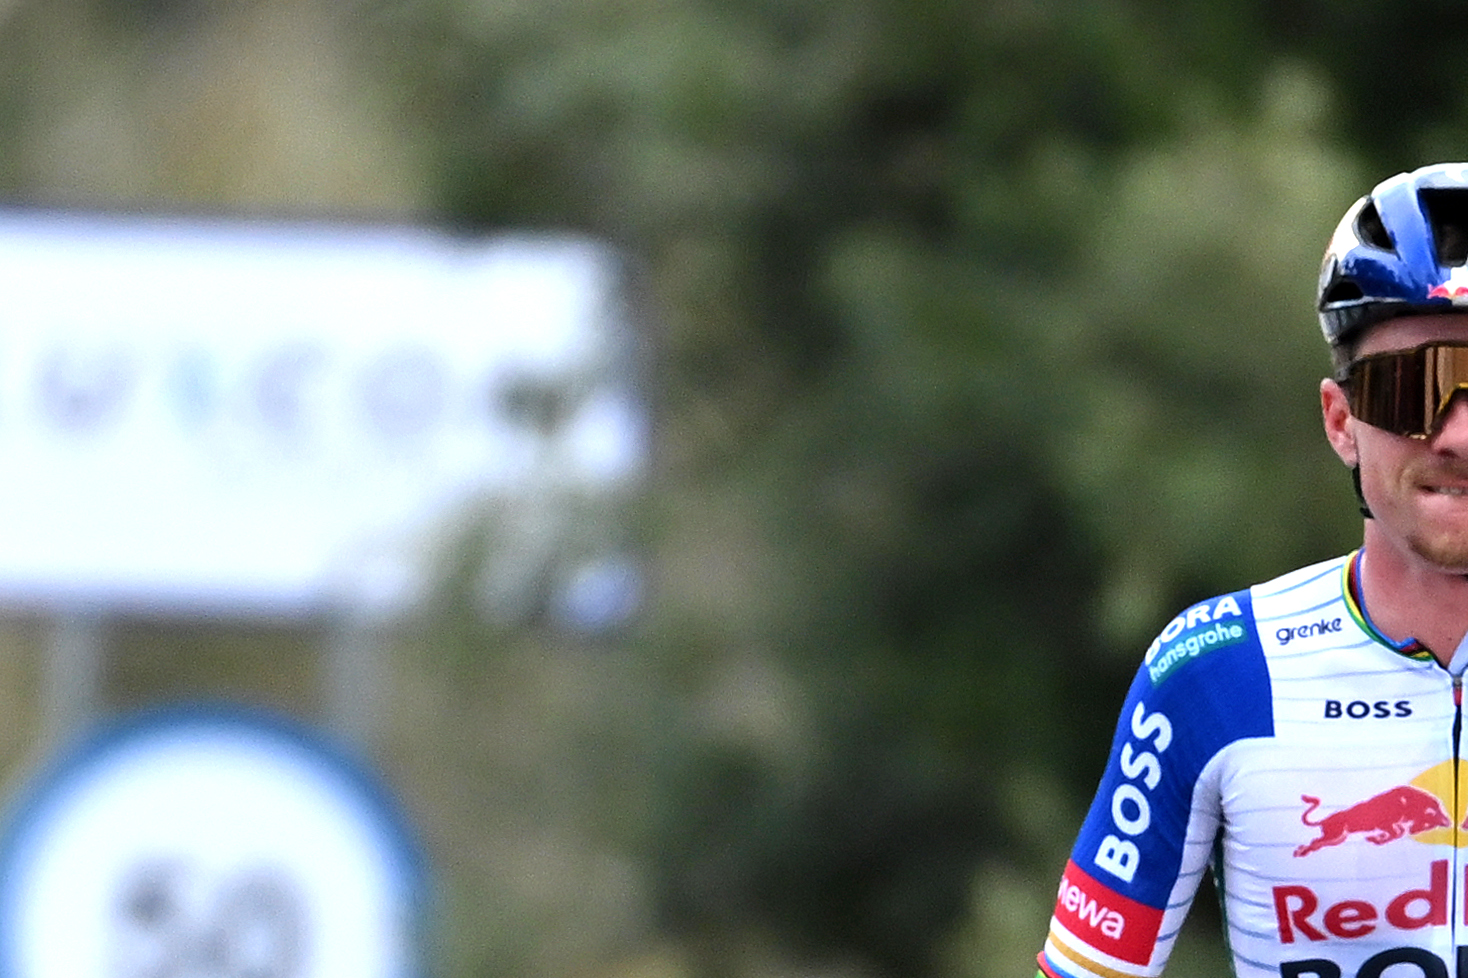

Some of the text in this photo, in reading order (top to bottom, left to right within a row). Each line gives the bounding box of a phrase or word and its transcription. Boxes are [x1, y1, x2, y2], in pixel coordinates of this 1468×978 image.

[1149, 622, 1243, 682] hansgrohe
[1276, 617, 1342, 645] grenke
[1324, 700, 1413, 719] BOSS
[1094, 701, 1173, 883] BOSS
[1272, 859, 1448, 944] Red
